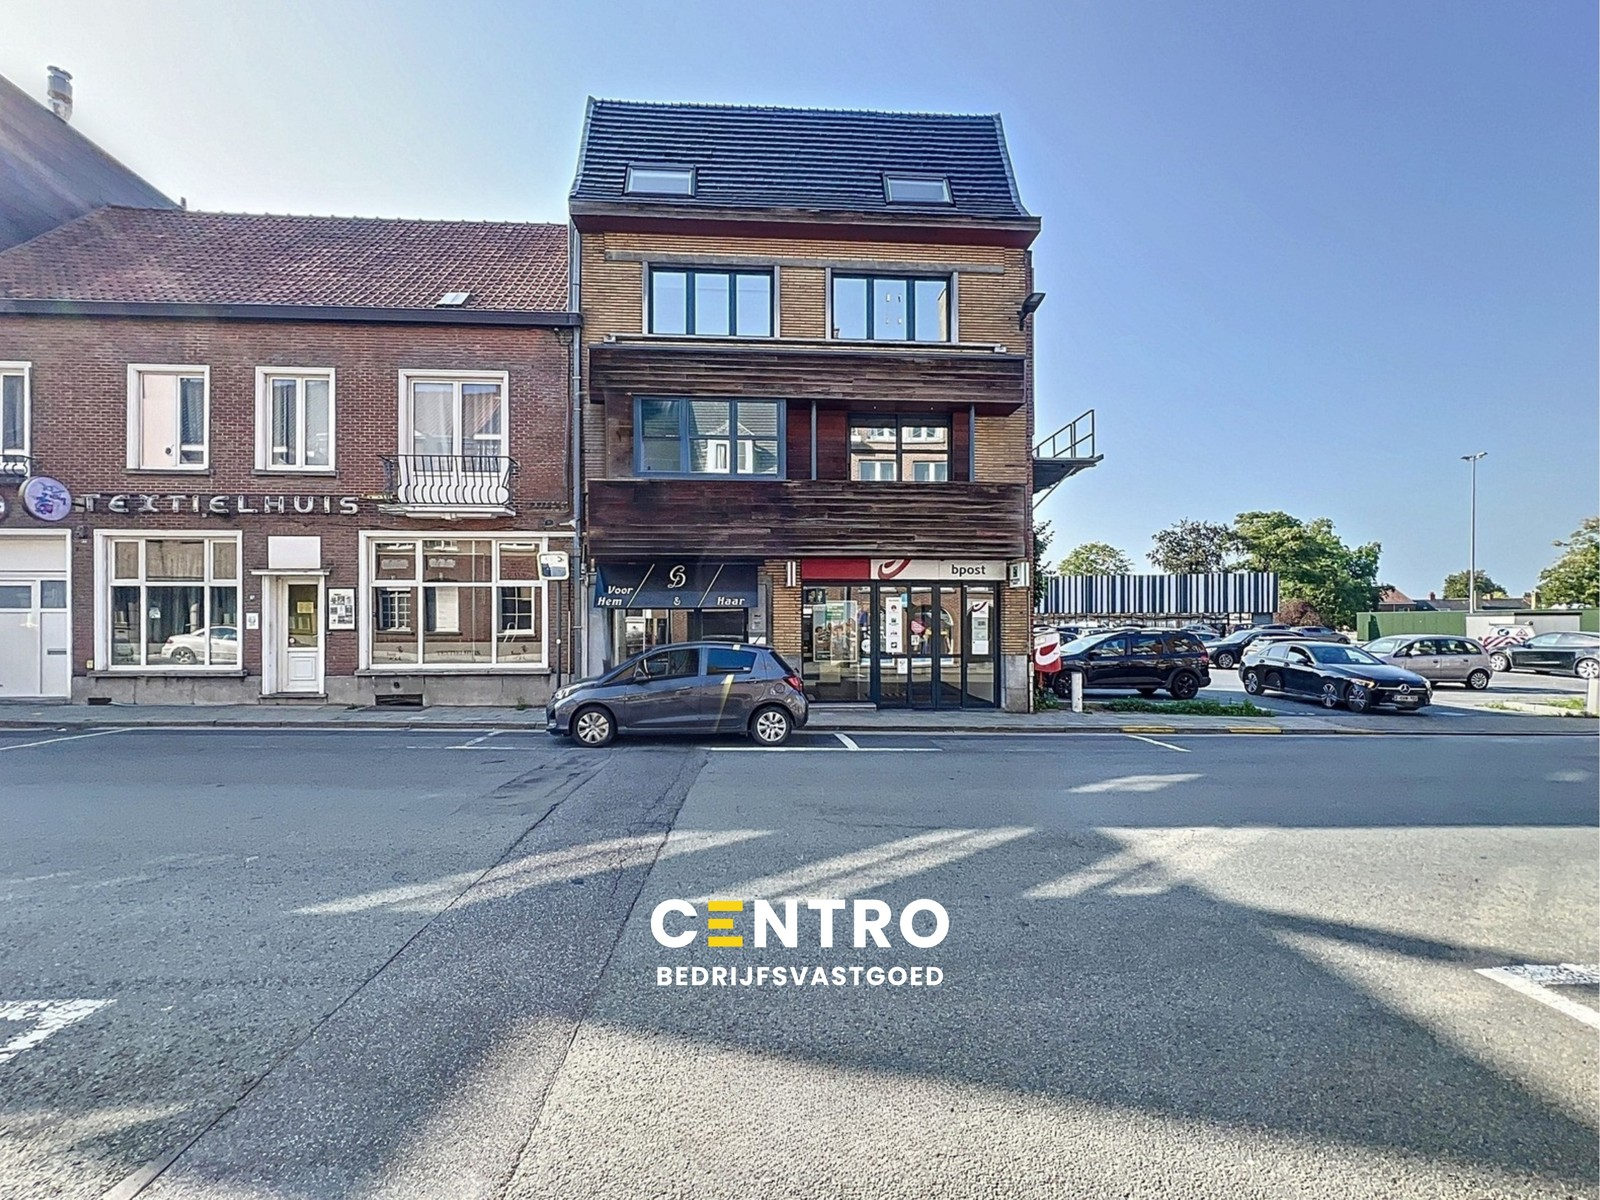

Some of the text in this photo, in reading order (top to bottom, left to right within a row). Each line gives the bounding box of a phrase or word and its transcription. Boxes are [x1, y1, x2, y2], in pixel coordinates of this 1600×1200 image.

[81, 493, 359, 514] TEXTIELHUIS
[951, 564, 986, 577] bpost
[608, 586, 633, 595] Voor
[598, 597, 622, 606] Hem
[717, 597, 745, 605] Haar
